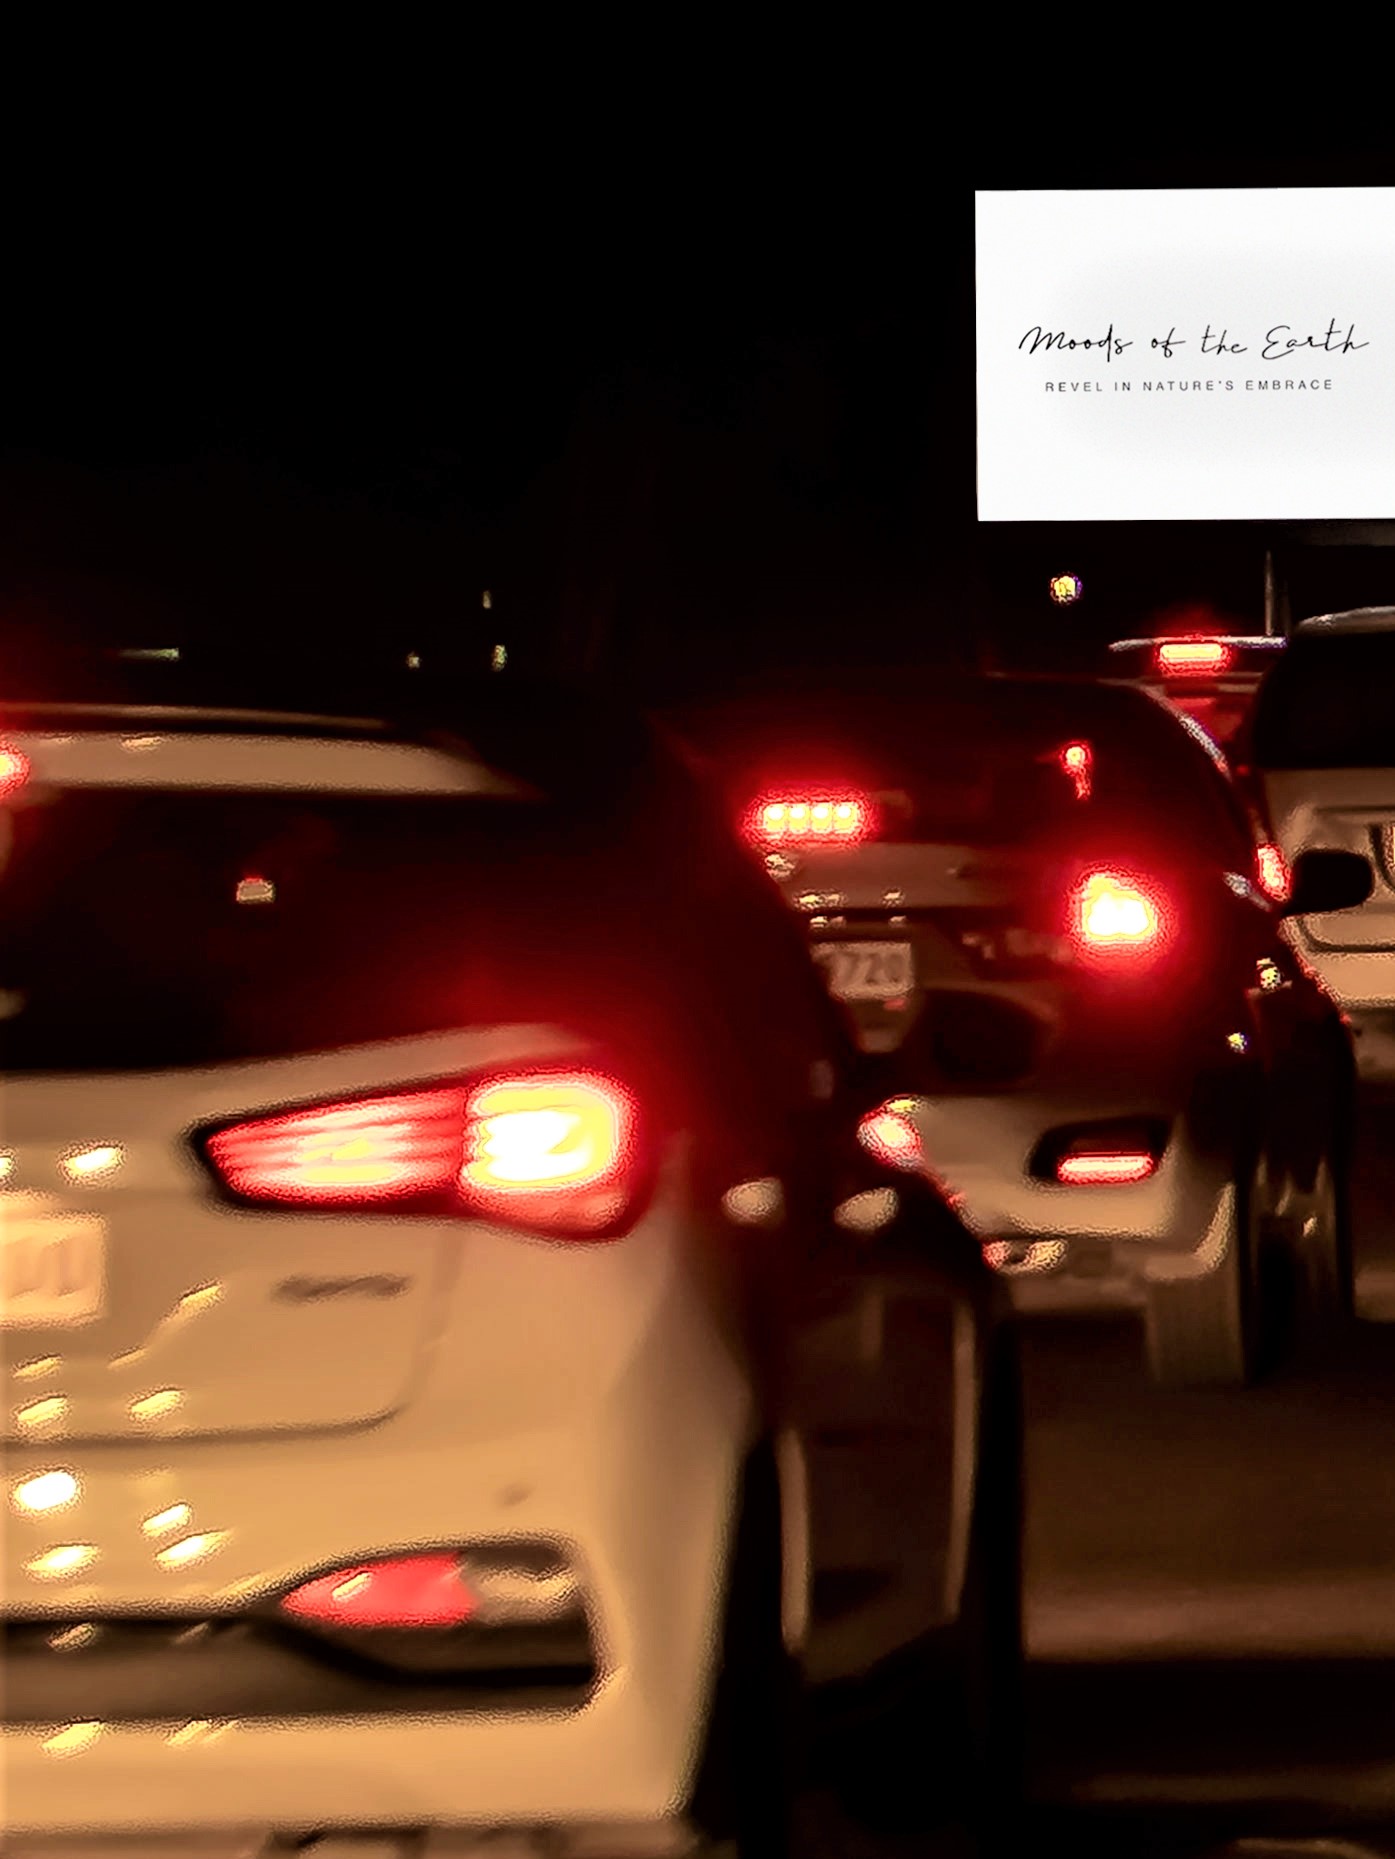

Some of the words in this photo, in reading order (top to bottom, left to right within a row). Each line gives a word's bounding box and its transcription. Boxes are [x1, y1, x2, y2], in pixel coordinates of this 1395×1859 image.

[1017, 323, 1134, 363] Moods
[1150, 326, 1187, 359] of
[1200, 324, 1249, 356] the
[1260, 317, 1370, 361] Earth
[1045, 381, 1103, 393] REVEL
[1114, 381, 1131, 392] IN
[1142, 379, 1235, 392] NATURE'S
[1245, 378, 1333, 391] EMBRACE
